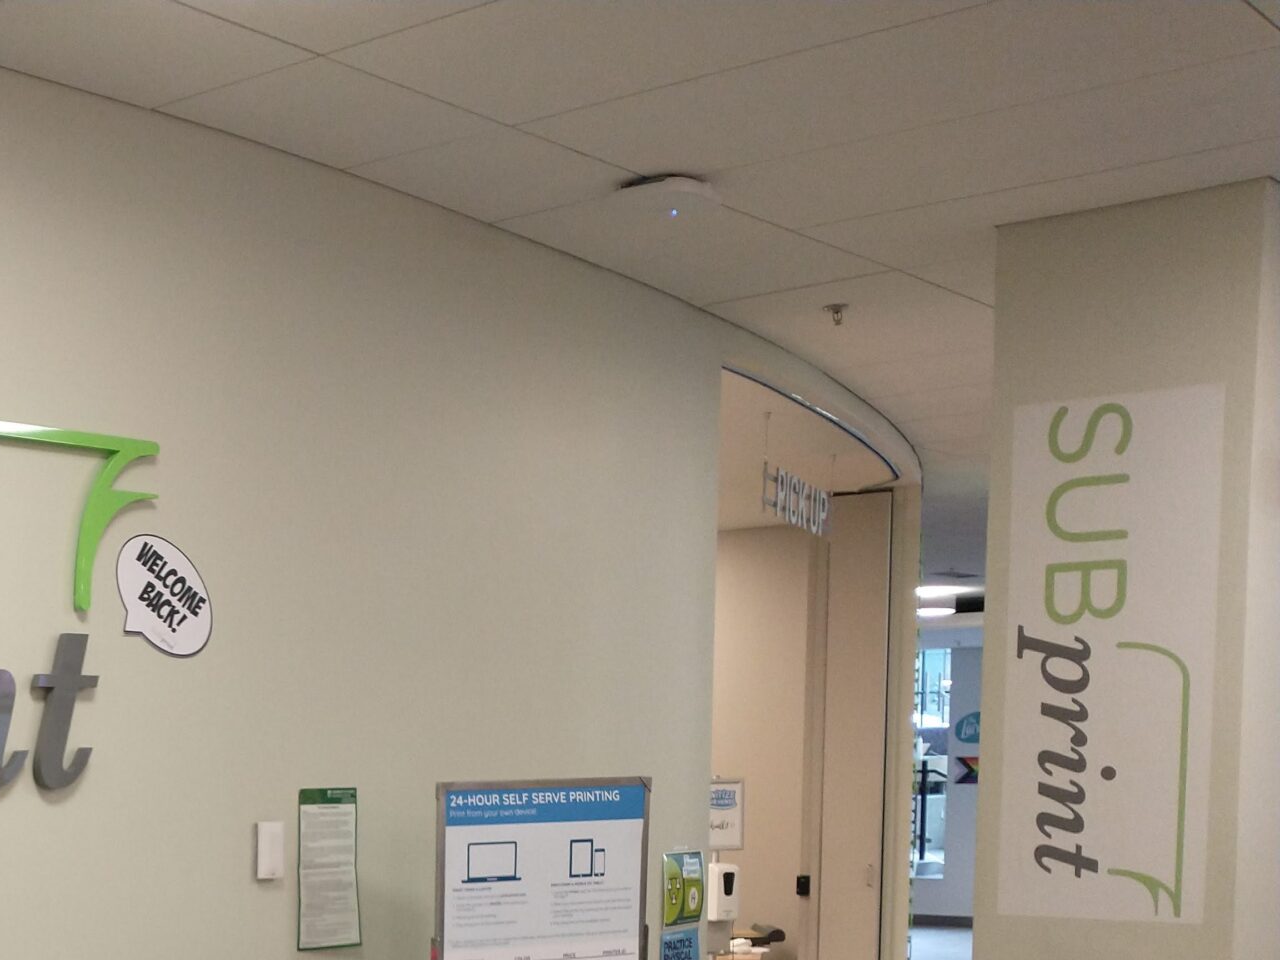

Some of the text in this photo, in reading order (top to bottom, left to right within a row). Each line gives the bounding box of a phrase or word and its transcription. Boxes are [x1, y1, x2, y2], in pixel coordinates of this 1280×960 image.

[135, 541, 207, 618] WELCOME
[137, 580, 188, 633] BACK!
[449, 789, 620, 807] 24-HOUR SELF SERVE PRINTING
[663, 937, 693, 953] PRACTICE
